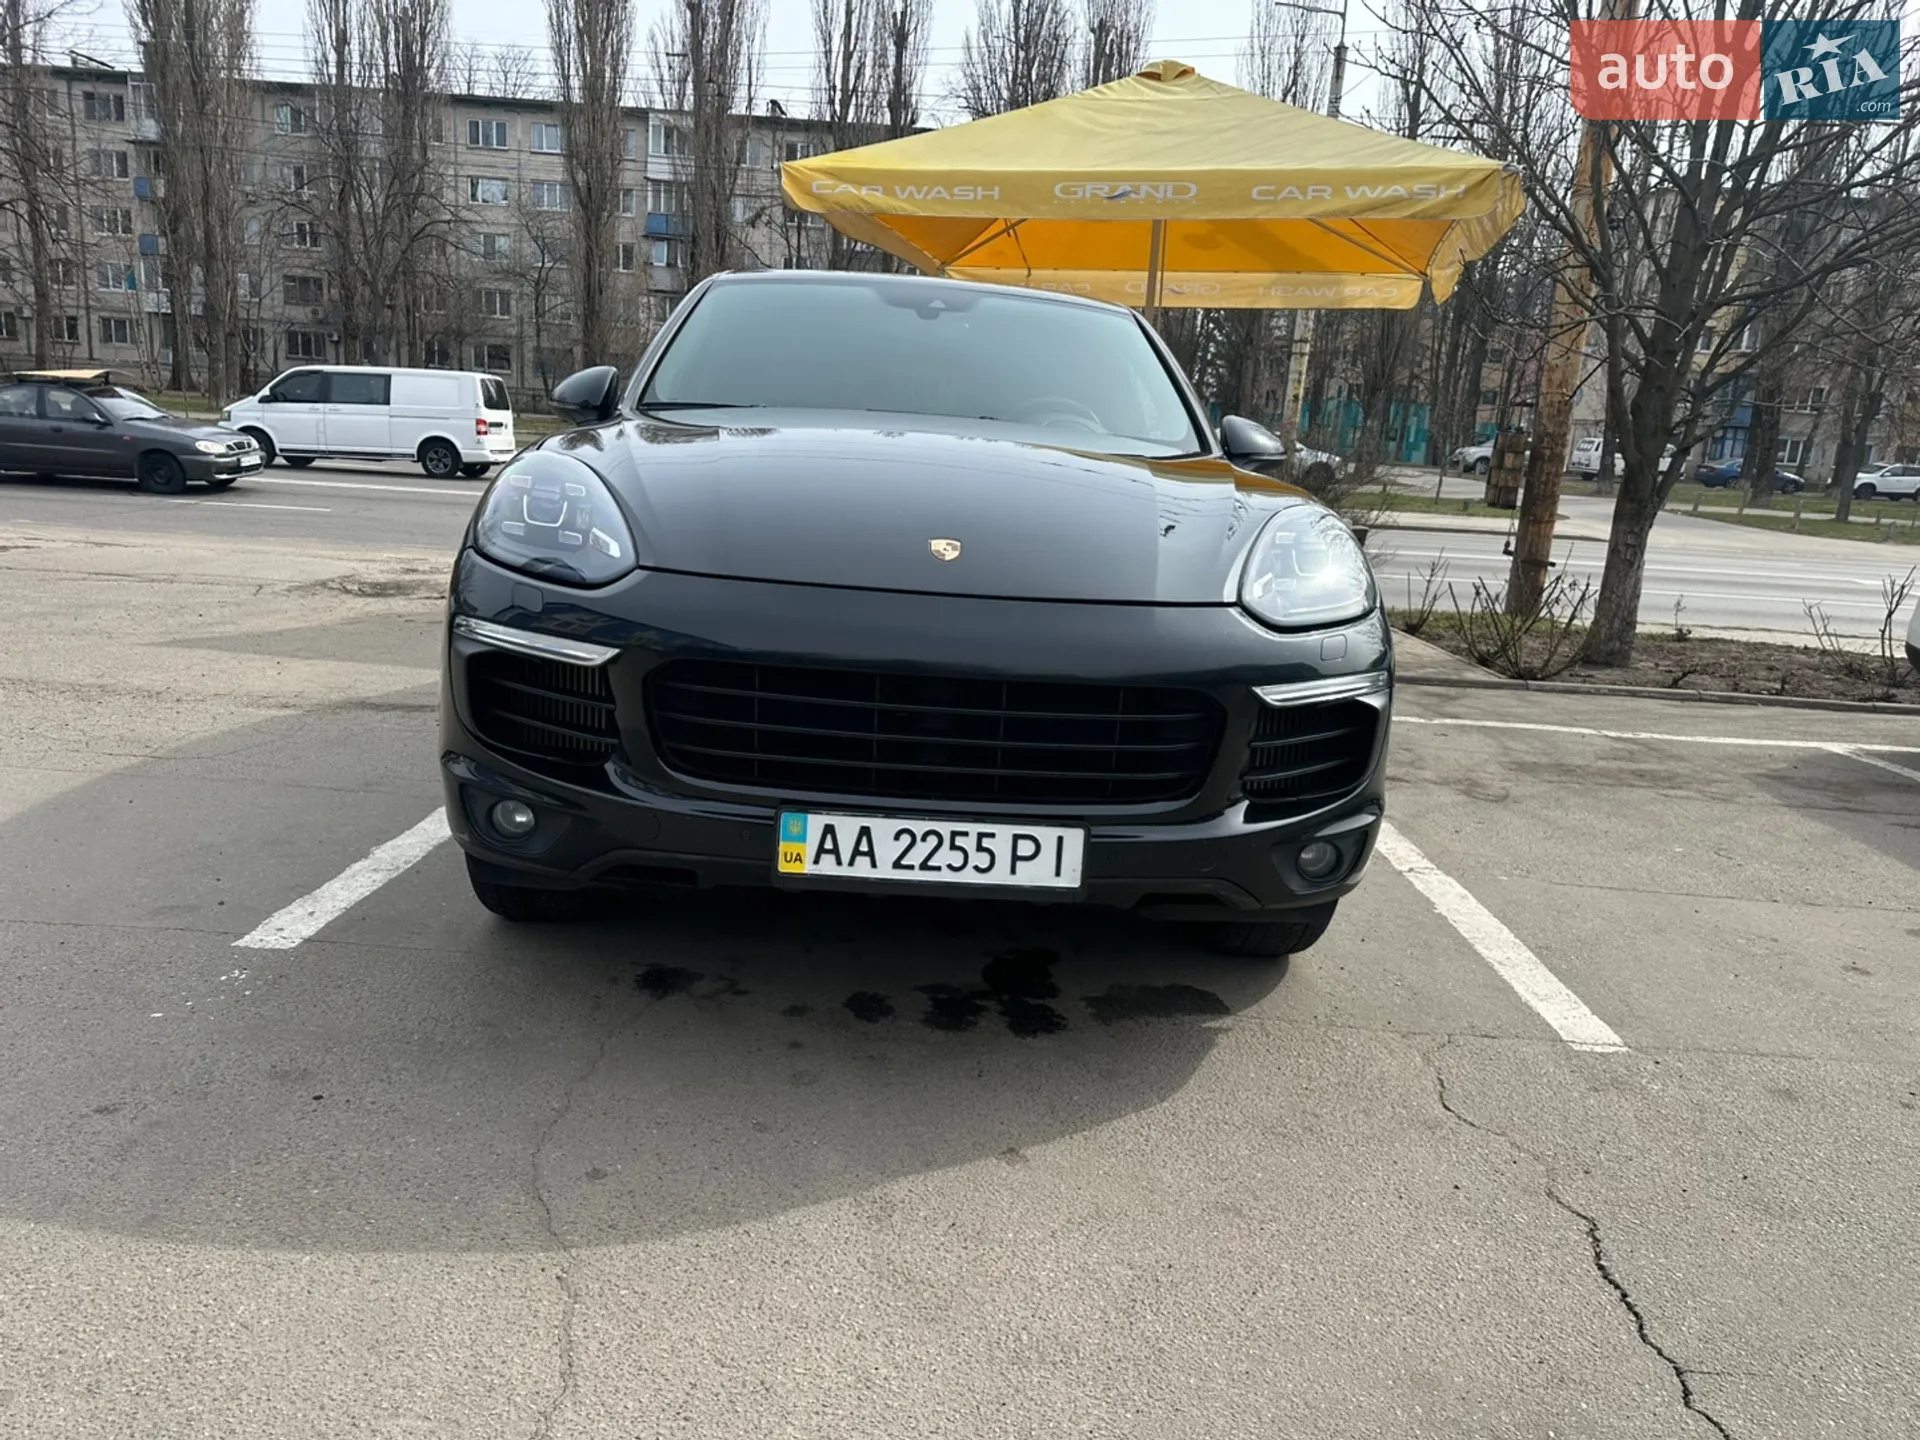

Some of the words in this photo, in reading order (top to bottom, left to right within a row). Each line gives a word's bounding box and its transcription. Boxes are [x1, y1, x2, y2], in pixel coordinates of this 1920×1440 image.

[812, 180, 884, 197] CAR
[894, 185, 1000, 200] WASH
[1054, 181, 1198, 200] GRAND
[1251, 185, 1332, 200] CAR
[1343, 184, 1466, 199] WASH
[784, 851, 804, 865] UA
[812, 823, 878, 869] AA
[892, 827, 997, 874] 2255
[1009, 832, 1065, 878] PI
